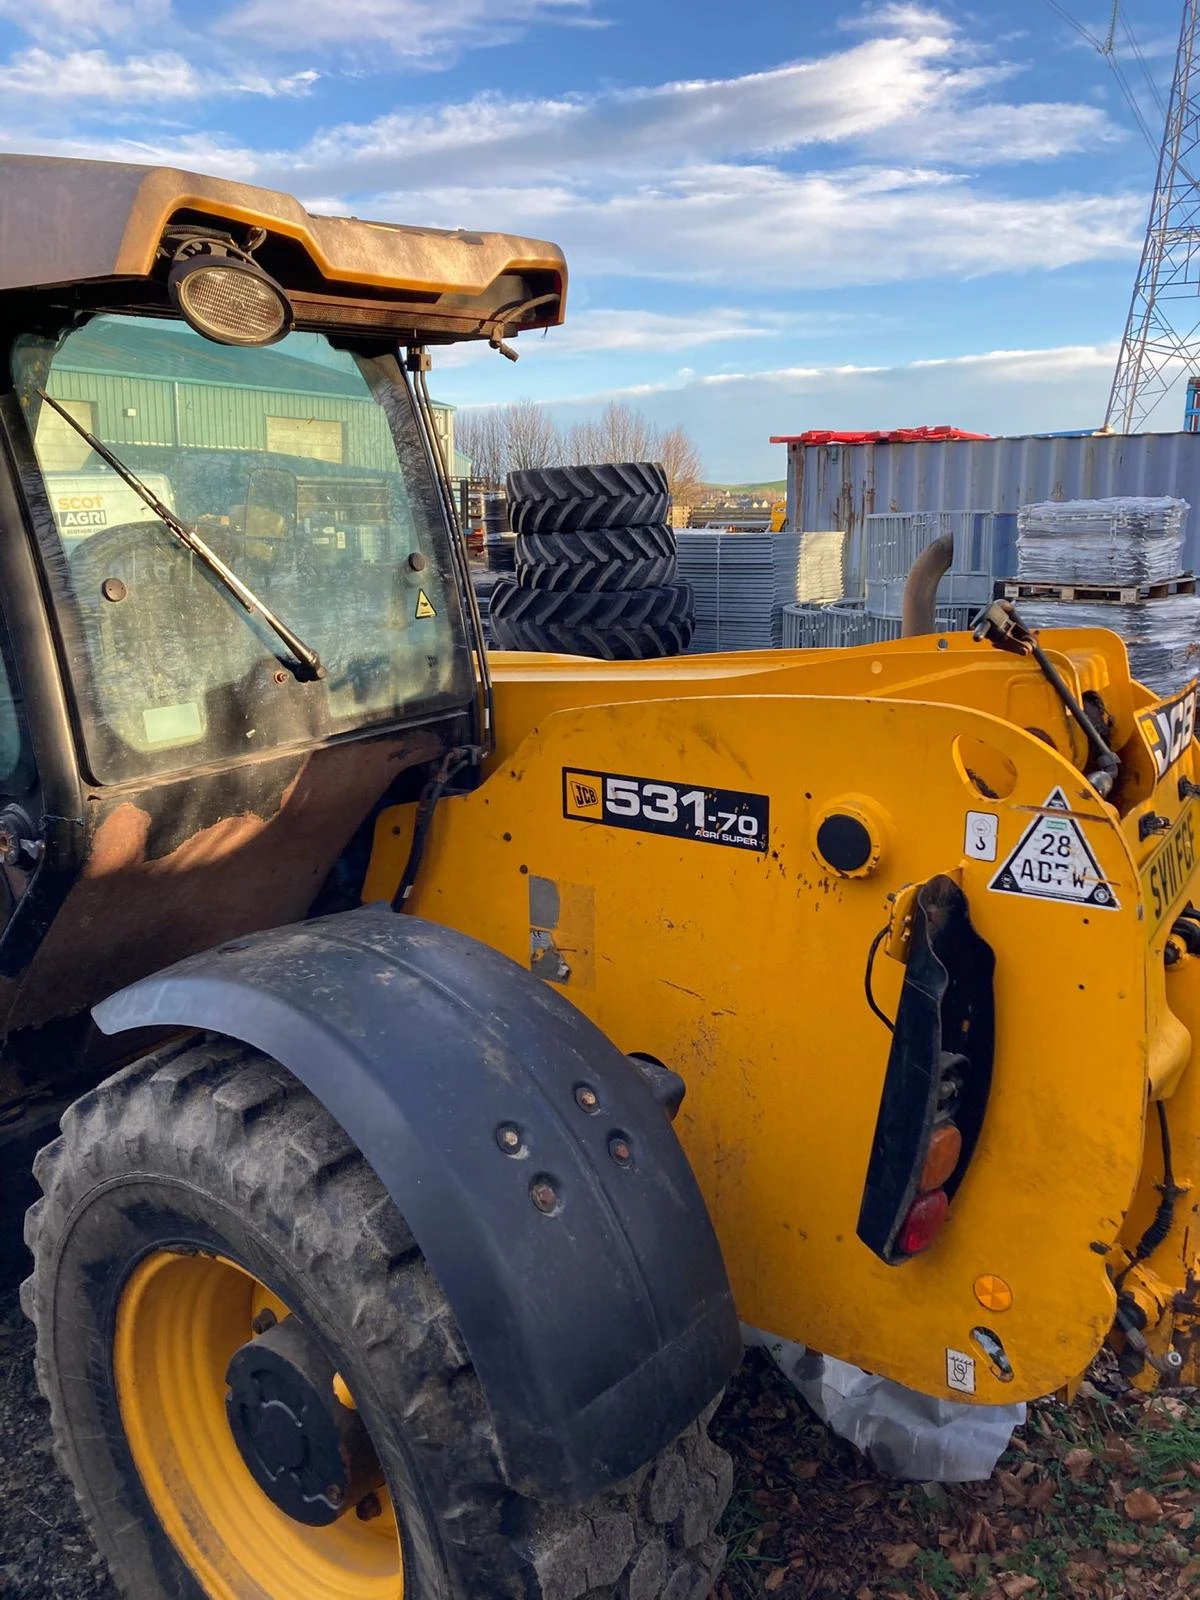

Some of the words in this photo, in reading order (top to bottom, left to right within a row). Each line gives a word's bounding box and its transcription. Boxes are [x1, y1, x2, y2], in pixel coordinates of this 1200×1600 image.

[58, 496, 104, 510] SCOT
[64, 511, 106, 525] AGRI
[1155, 691, 1195, 777] JCB
[573, 784, 597, 805] JCB
[694, 829, 720, 841] AGRI
[721, 833, 758, 847] SUPER
[1040, 833, 1071, 858] 28
